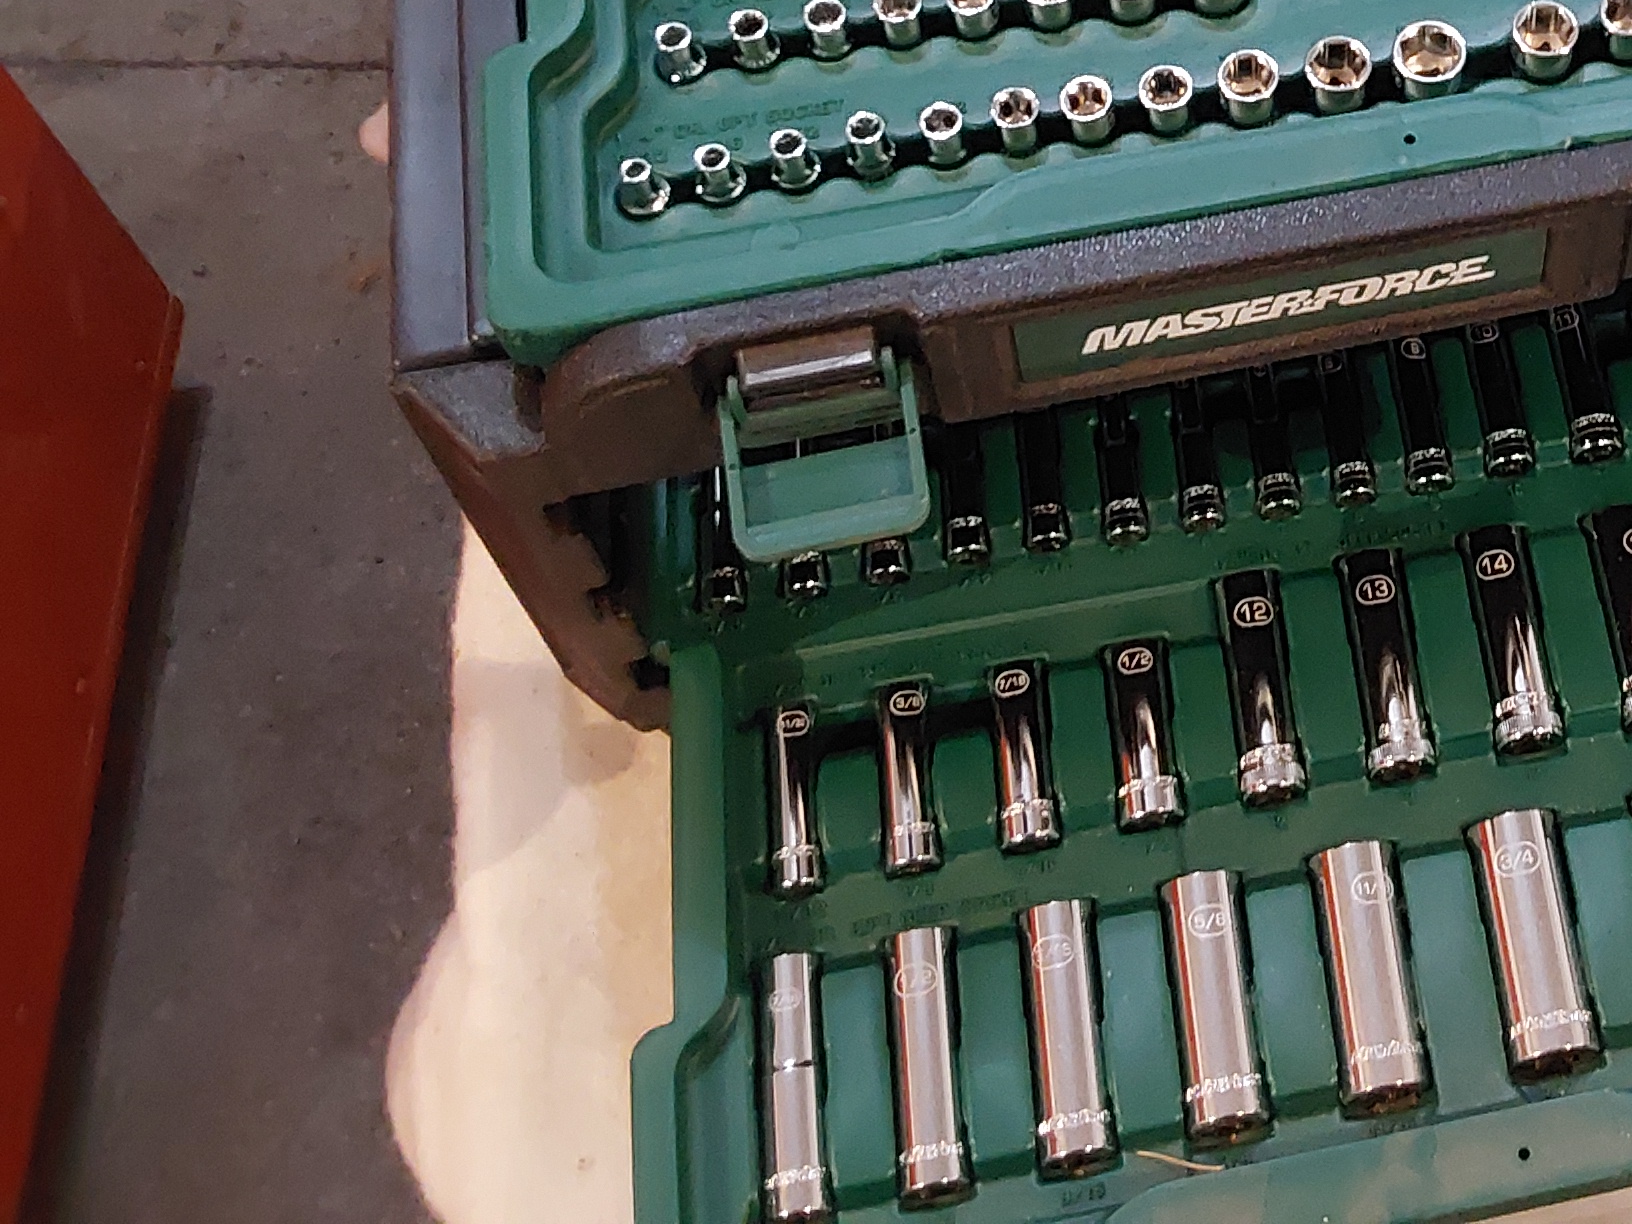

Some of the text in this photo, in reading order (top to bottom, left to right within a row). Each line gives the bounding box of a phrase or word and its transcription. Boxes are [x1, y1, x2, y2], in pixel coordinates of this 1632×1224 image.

[1082, 255, 1496, 355] MASTERFORCE
[1481, 556, 1508, 574] 14
[1362, 581, 1389, 600] 13
[1241, 603, 1269, 621] 12
[1122, 651, 1151, 669] 1/2
[1501, 851, 1535, 869] 3/4
